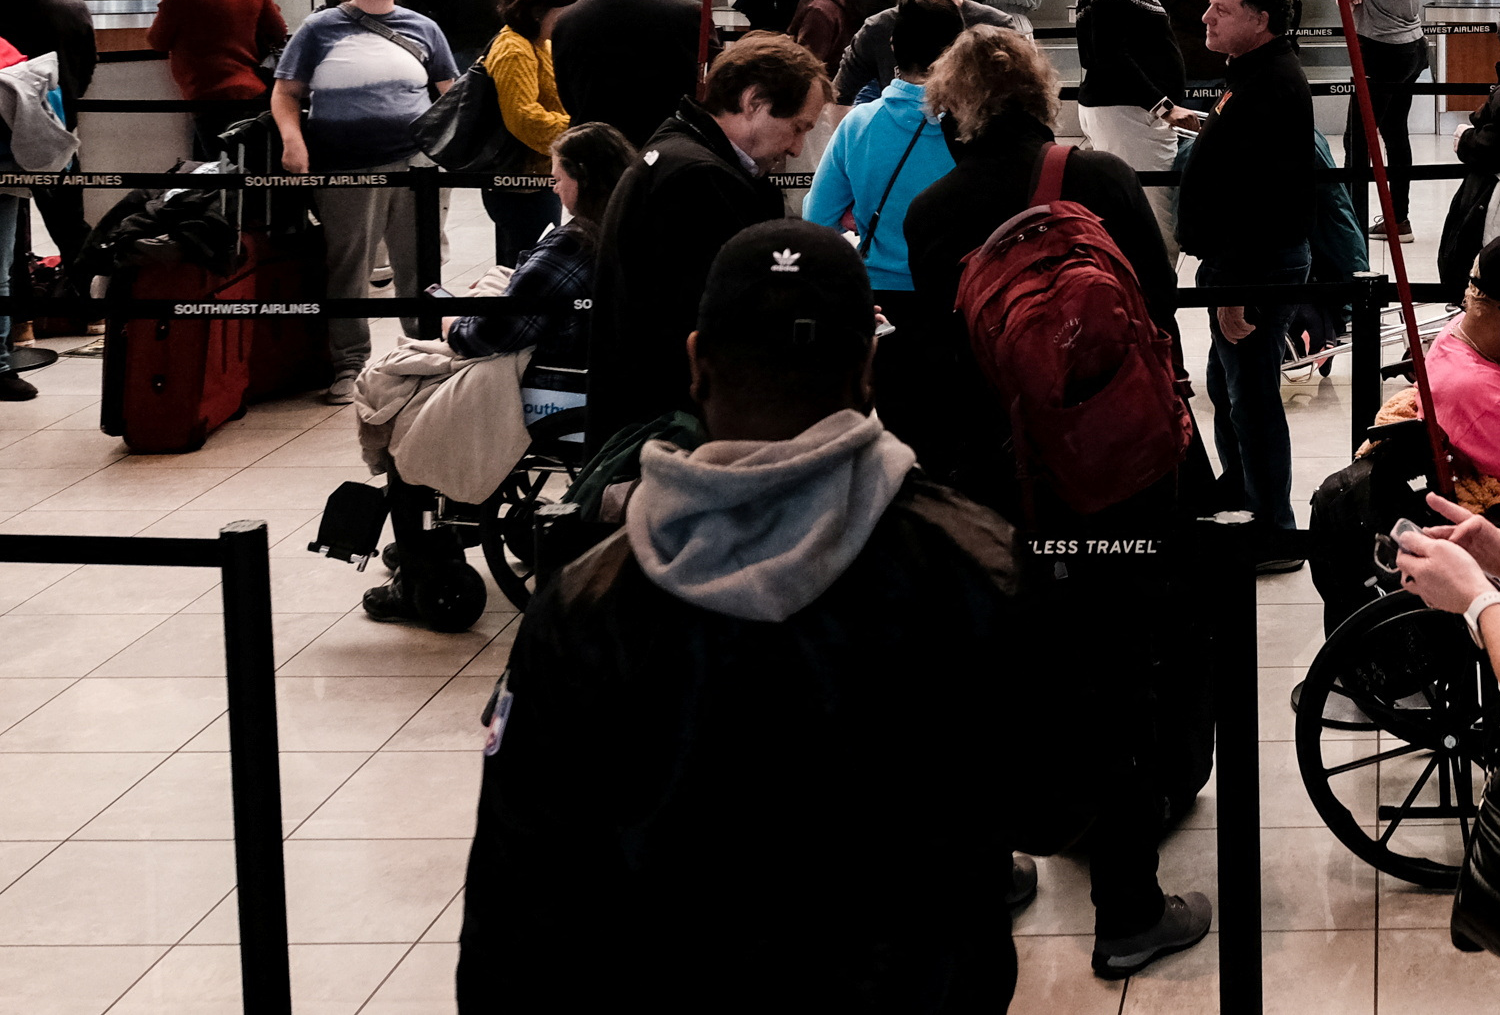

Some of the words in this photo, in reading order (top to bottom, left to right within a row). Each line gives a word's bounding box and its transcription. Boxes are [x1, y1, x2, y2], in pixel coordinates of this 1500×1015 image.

[1295, 28, 1333, 36] AIRLINES
[1454, 26, 1490, 34] AIRLINES
[62, 175, 123, 186] AIRLINES
[244, 176, 325, 187] SOUTHWEST
[328, 175, 388, 186] AIRLINES
[174, 303, 259, 315] SOUTHWEST
[260, 303, 320, 315] AIRLINES
[1030, 539, 1079, 555] LESS
